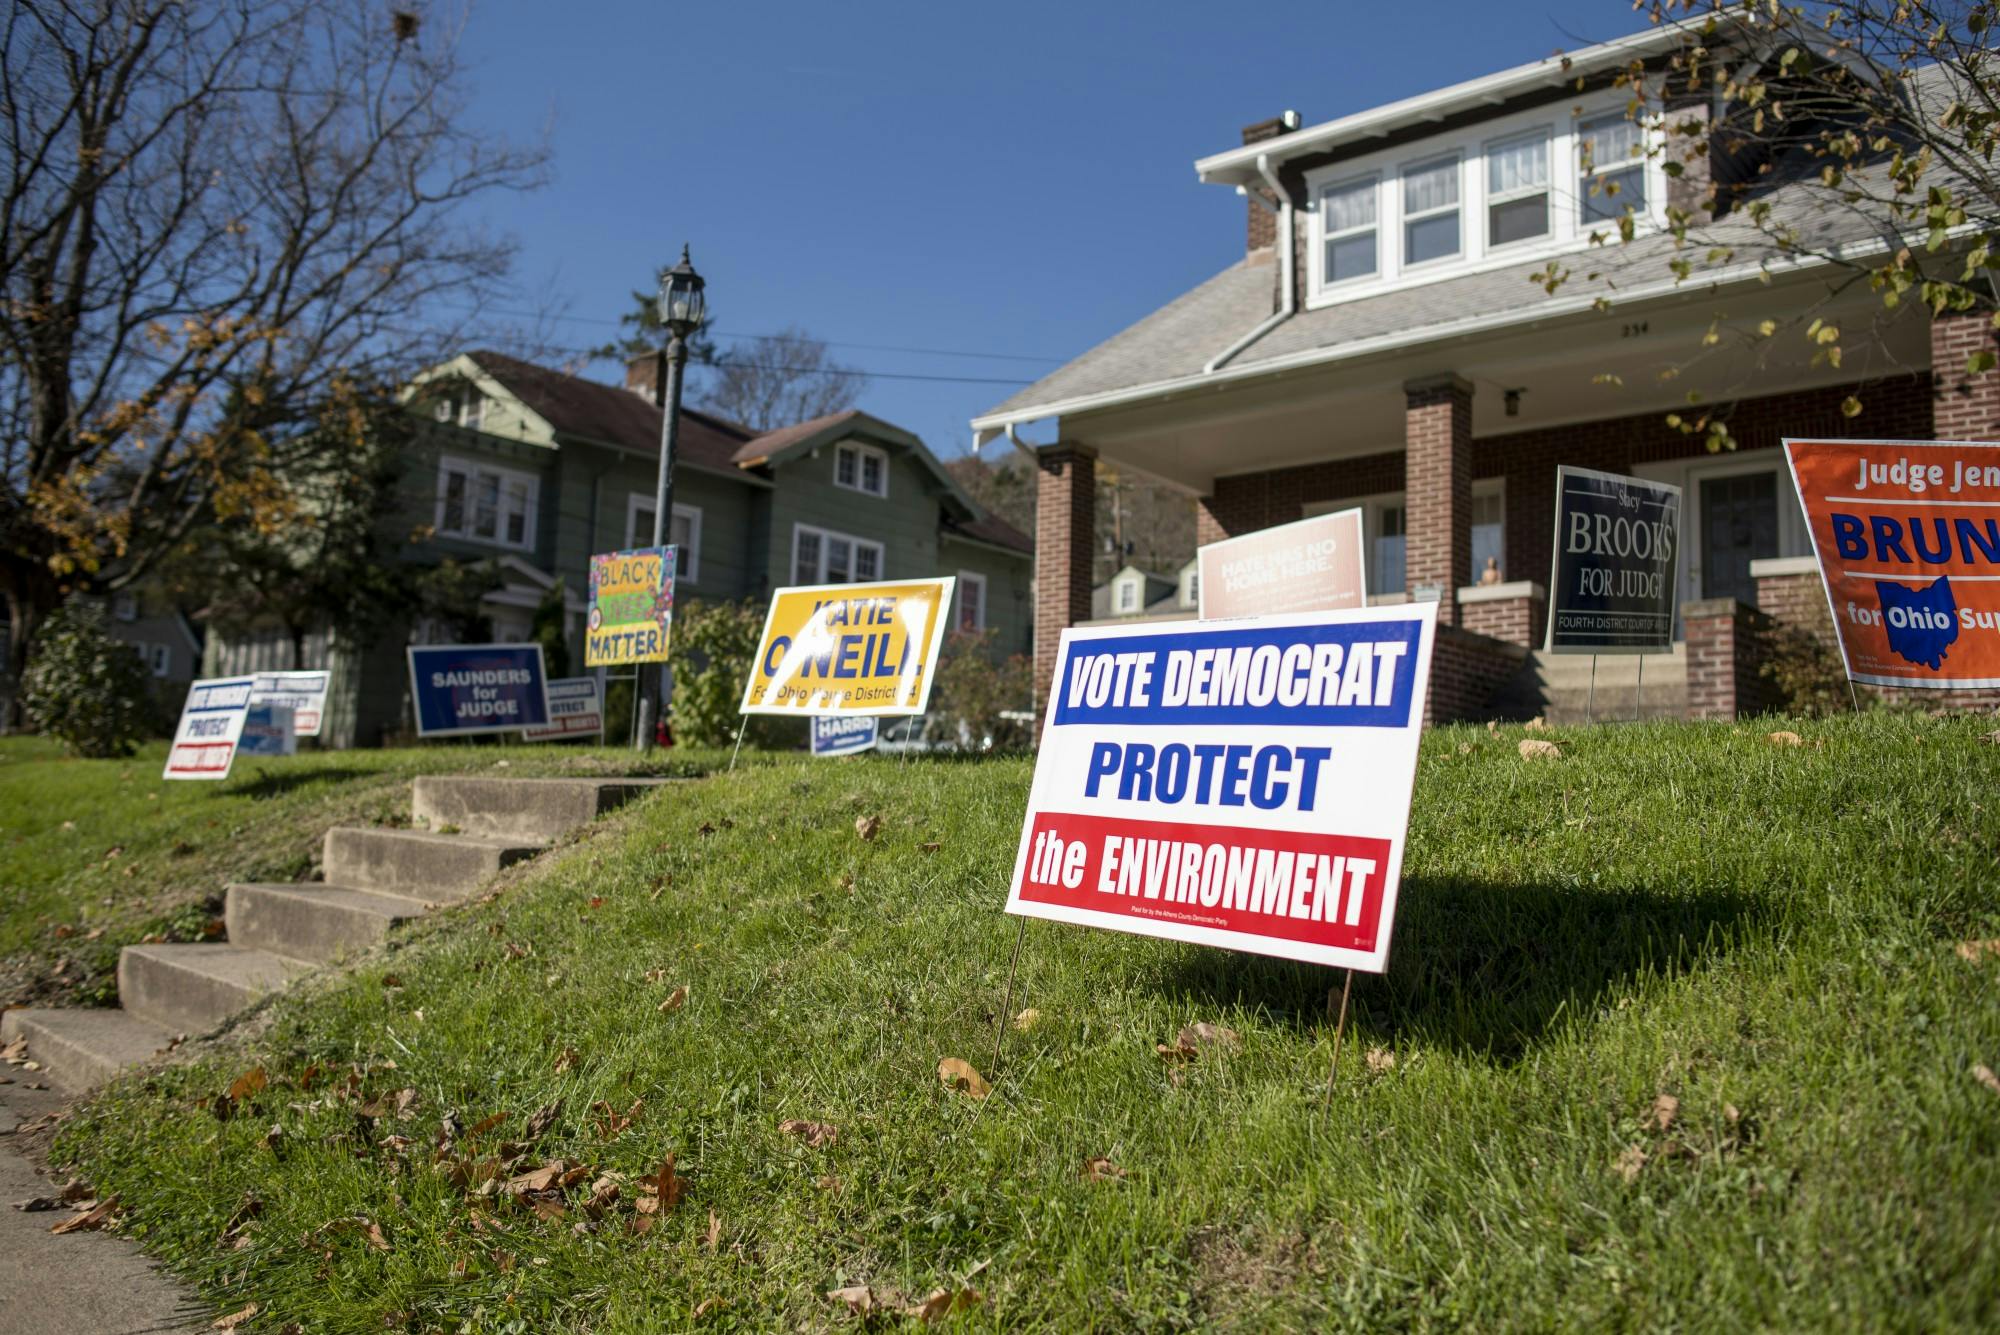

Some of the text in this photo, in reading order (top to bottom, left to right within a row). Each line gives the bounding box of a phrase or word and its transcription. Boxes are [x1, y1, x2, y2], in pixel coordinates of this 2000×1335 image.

[1855, 458, 2000, 493] Judge Jen
[1618, 488, 1640, 512] Stacy
[1307, 538, 1337, 555] NO
[1567, 511, 1673, 562] BROOKS
[1831, 513, 2000, 564] BRUN
[600, 561, 656, 587] BLACK
[1579, 568, 1664, 599] FOR JUDGE
[813, 597, 896, 627] KATIE
[1558, 616, 1594, 630] FOURTH
[1596, 616, 1628, 630] DISTRICT
[1848, 601, 1881, 626] for
[1888, 606, 1950, 630] Ohio
[763, 633, 922, 679] ONEILL
[432, 669, 532, 687] SAUNDERS
[1067, 641, 1408, 708] VOTE DEMOCRAT
[473, 687, 498, 700] for
[777, 684, 808, 699] Ohio
[812, 684, 852, 700] Houe
[855, 682, 896, 700] District
[456, 702, 519, 718] JUDGE
[1084, 741, 1332, 812] PROTECT
[1029, 829, 1376, 927] the ENVIRONMENT
